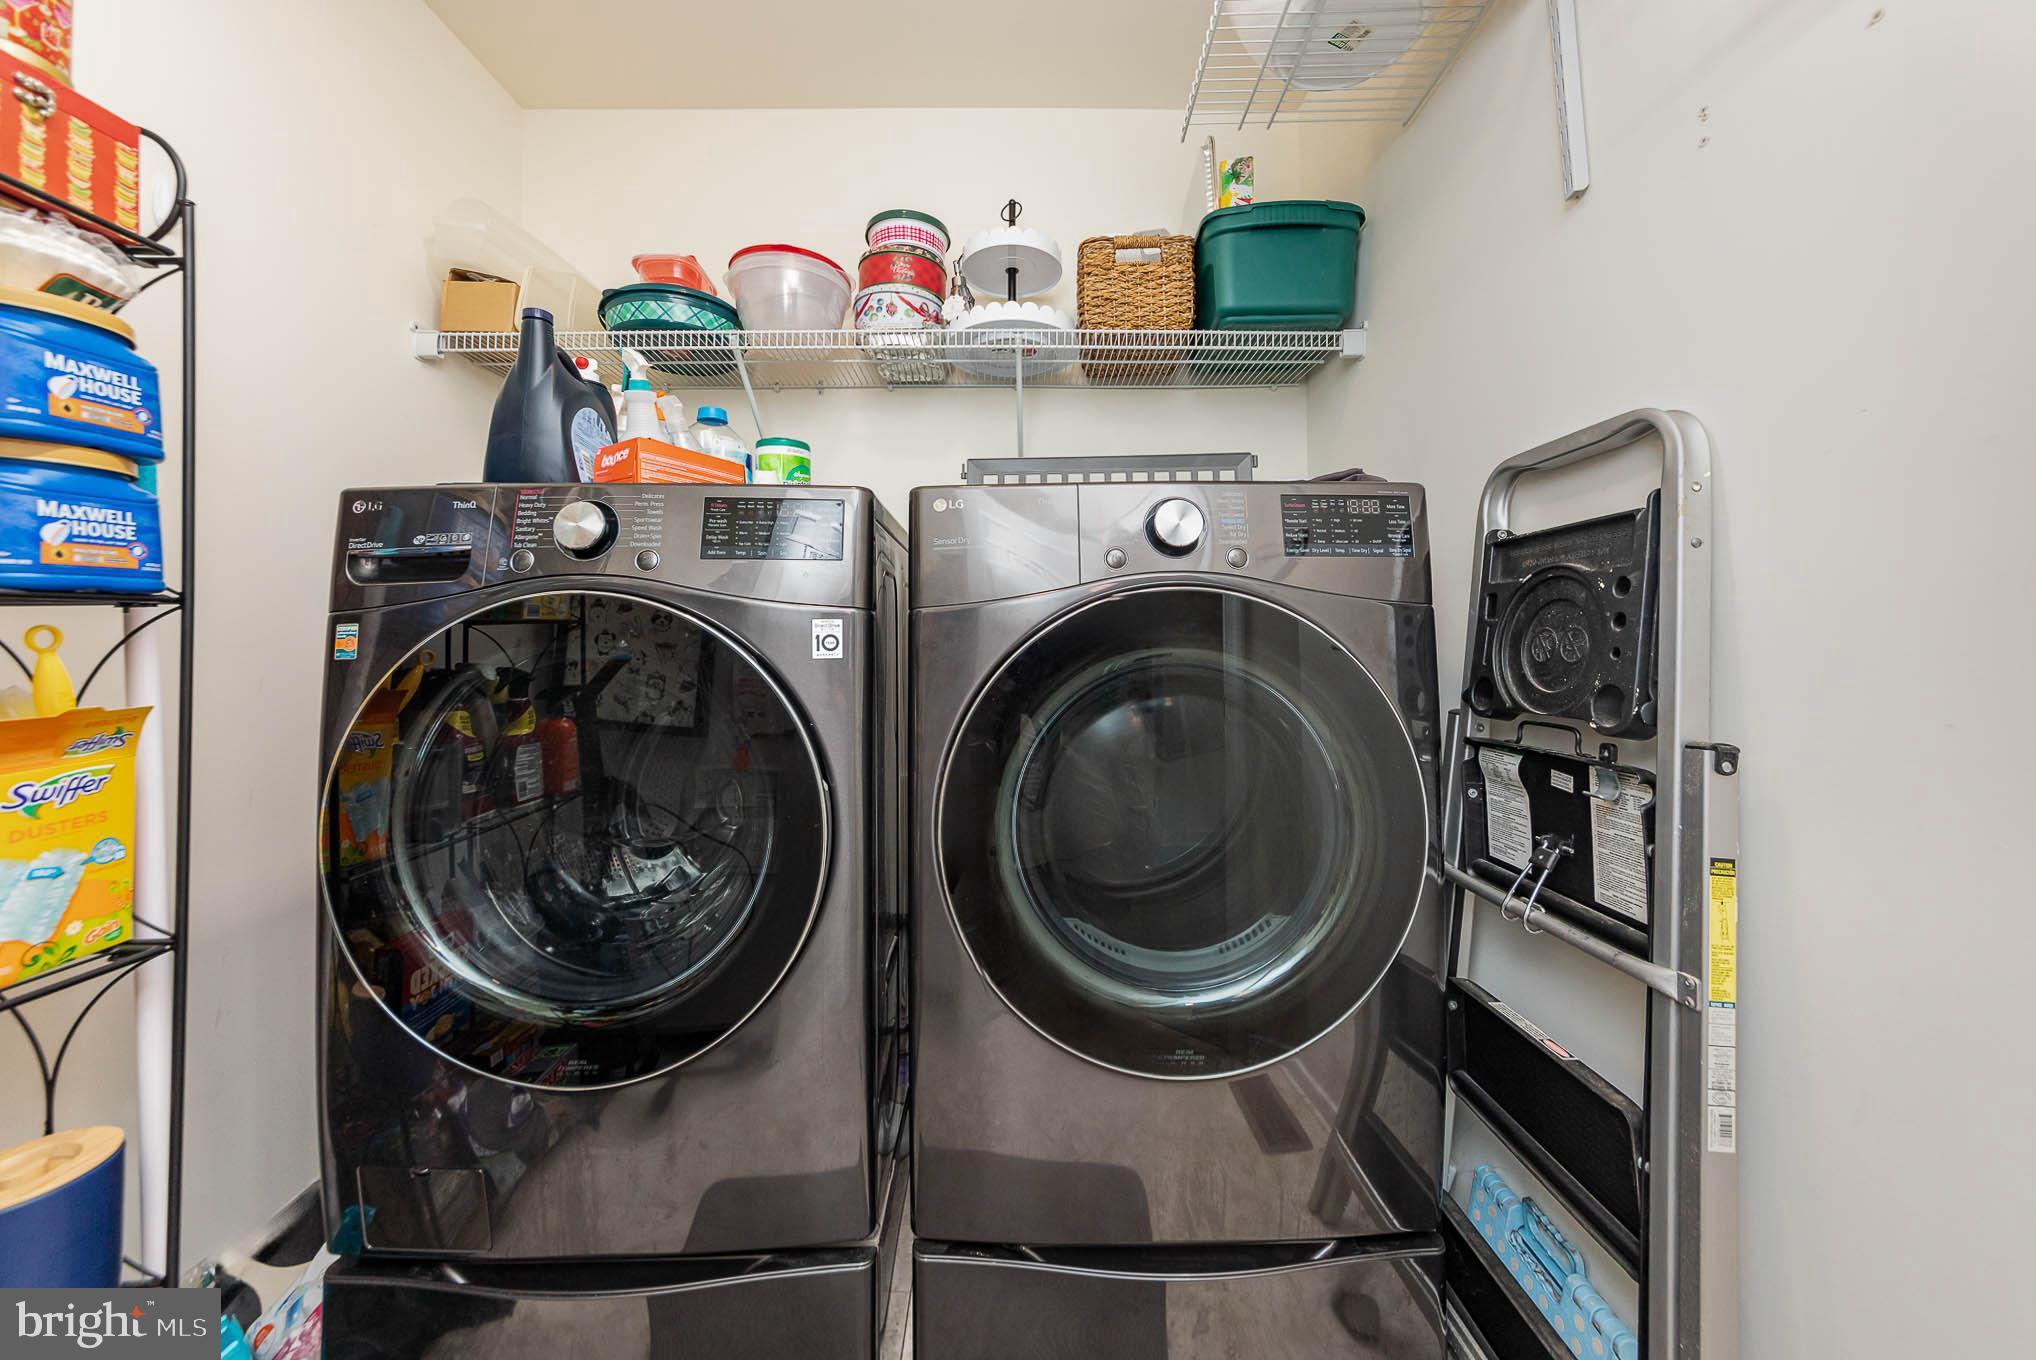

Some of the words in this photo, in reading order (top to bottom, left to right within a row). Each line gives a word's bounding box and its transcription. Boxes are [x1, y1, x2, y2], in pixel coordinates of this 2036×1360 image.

[43, 350, 142, 392] MAXWELL
[79, 376, 143, 406] HOUSE
[600, 447, 630, 469] bounce
[36, 499, 137, 526] MAXWELL
[452, 500, 477, 510] ThinQ
[71, 520, 138, 541] HOUSE
[815, 633, 840, 652] 10
[0, 773, 112, 811] Swiffer
[8, 810, 110, 844] DUSTERS
[83, 919, 122, 946] Gain
